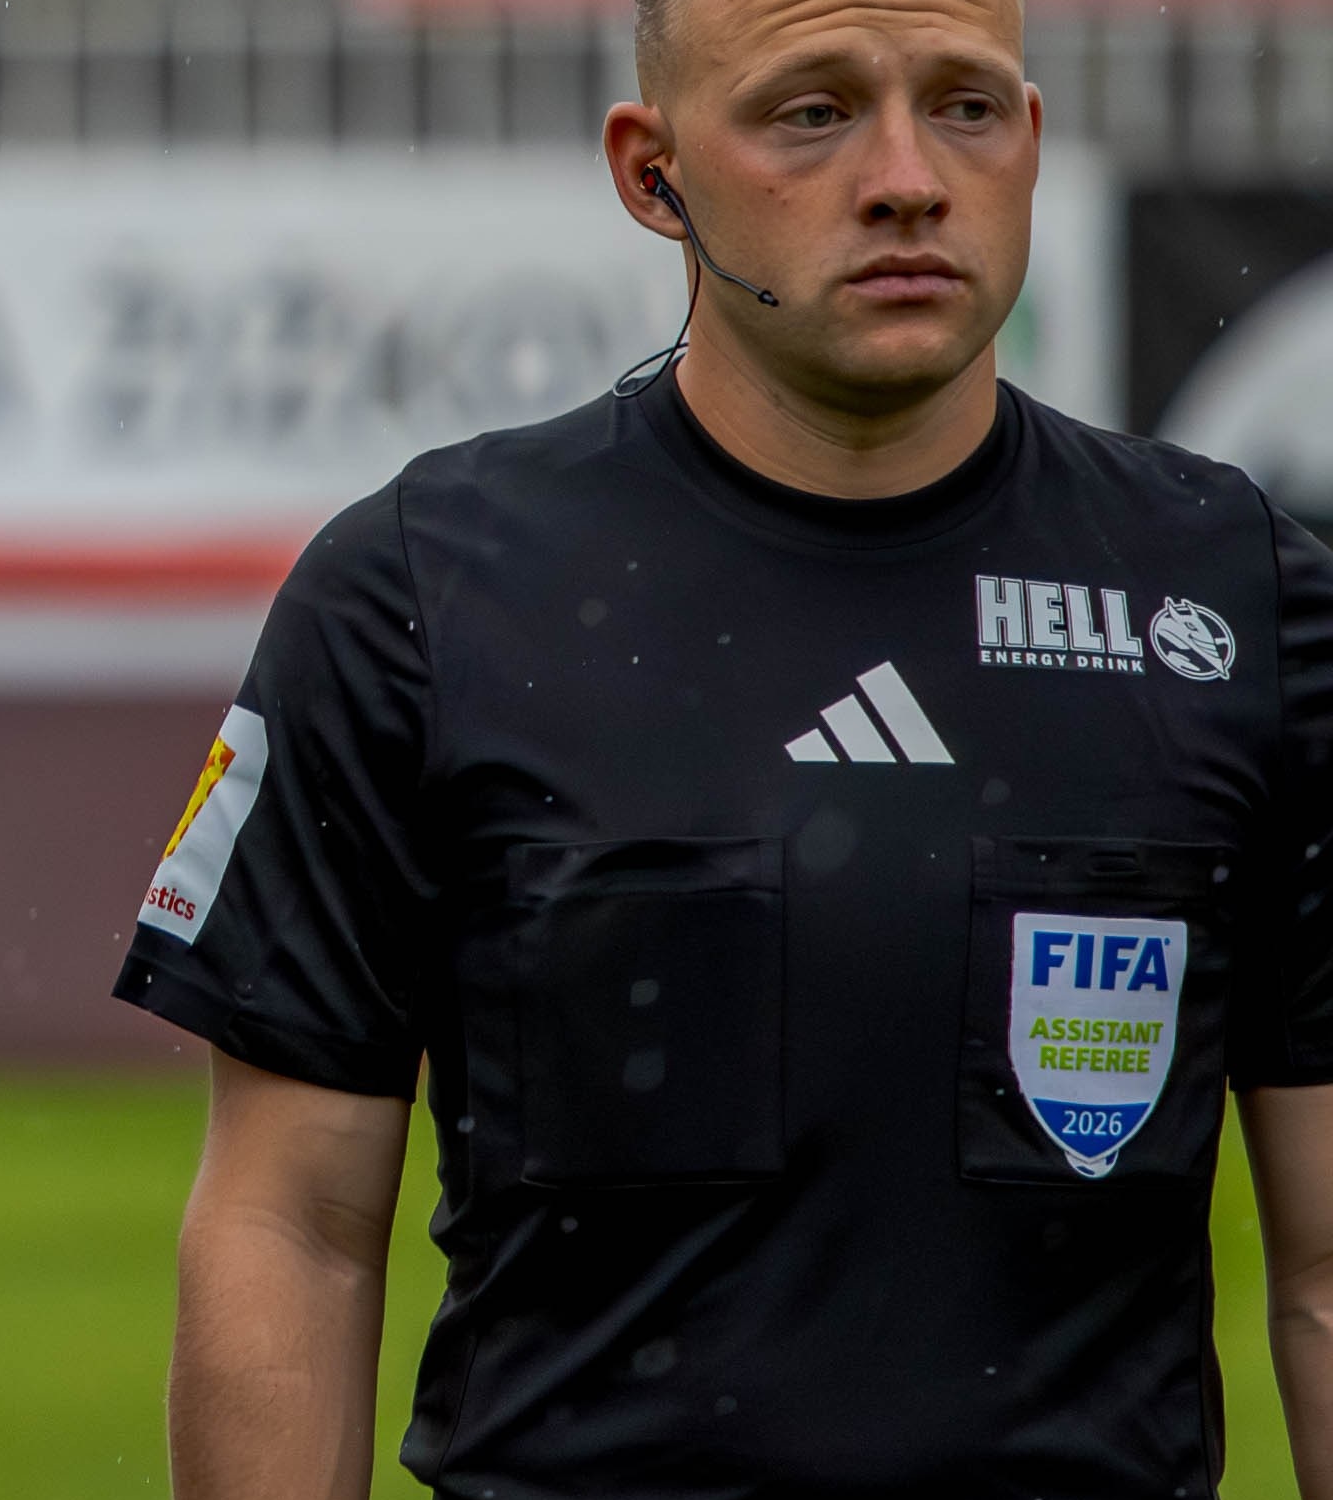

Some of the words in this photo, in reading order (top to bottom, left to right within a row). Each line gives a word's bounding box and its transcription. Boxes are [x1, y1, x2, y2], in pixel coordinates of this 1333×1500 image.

[976, 574, 1143, 657] HELL
[981, 650, 1067, 667] ENERGY
[1077, 656, 1144, 673] DRINK
[1031, 930, 1169, 991] FIFA
[1029, 1016, 1164, 1045] ASSISTANT
[1040, 1046, 1151, 1073] REFEREE
[1062, 1110, 1123, 1136] 2026
